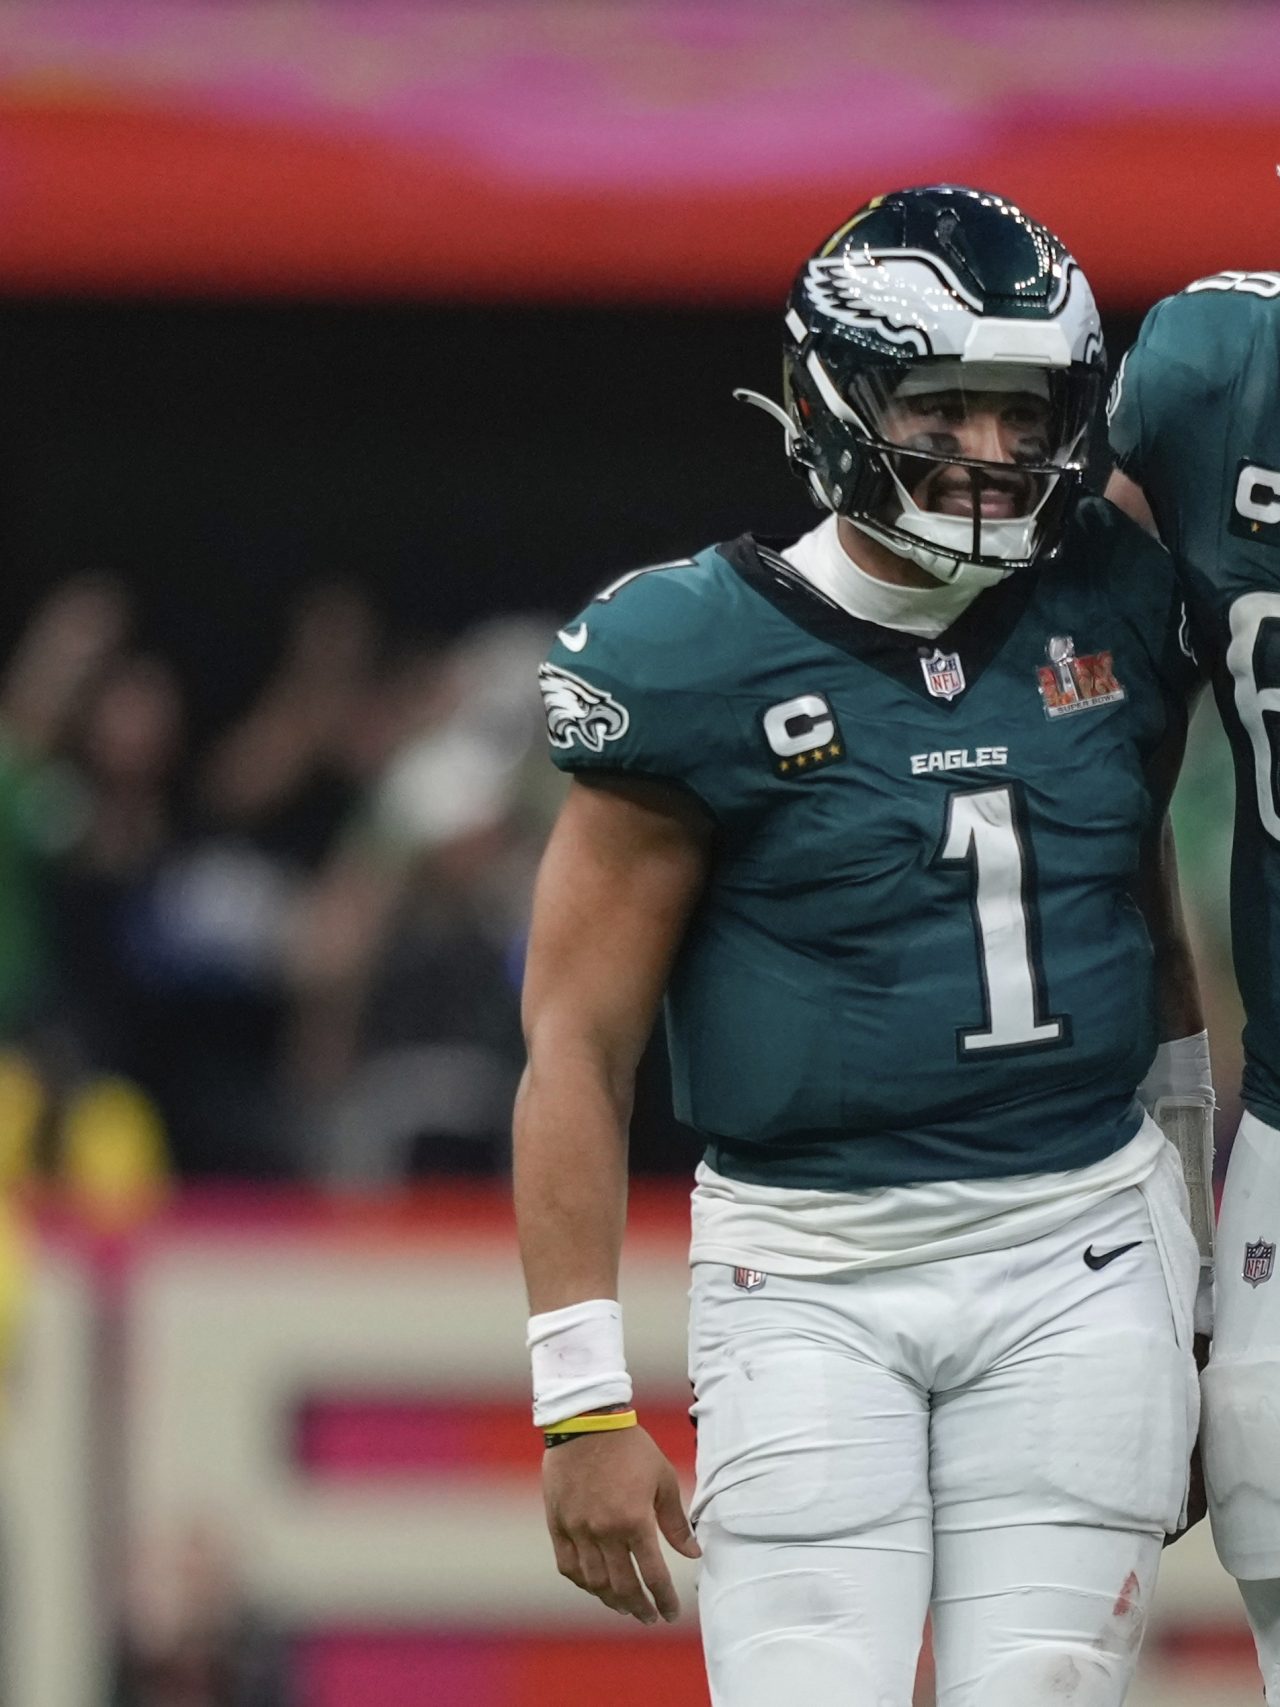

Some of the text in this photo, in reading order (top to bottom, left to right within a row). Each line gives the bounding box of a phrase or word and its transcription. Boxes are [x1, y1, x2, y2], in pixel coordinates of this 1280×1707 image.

[931, 672, 959, 691] NFL
[1057, 700, 1090, 714] SUPER
[763, 695, 835, 757] C
[910, 746, 1008, 775] EAGLES
[940, 786, 1062, 1053] 1
[1246, 1259, 1268, 1279] NFL
